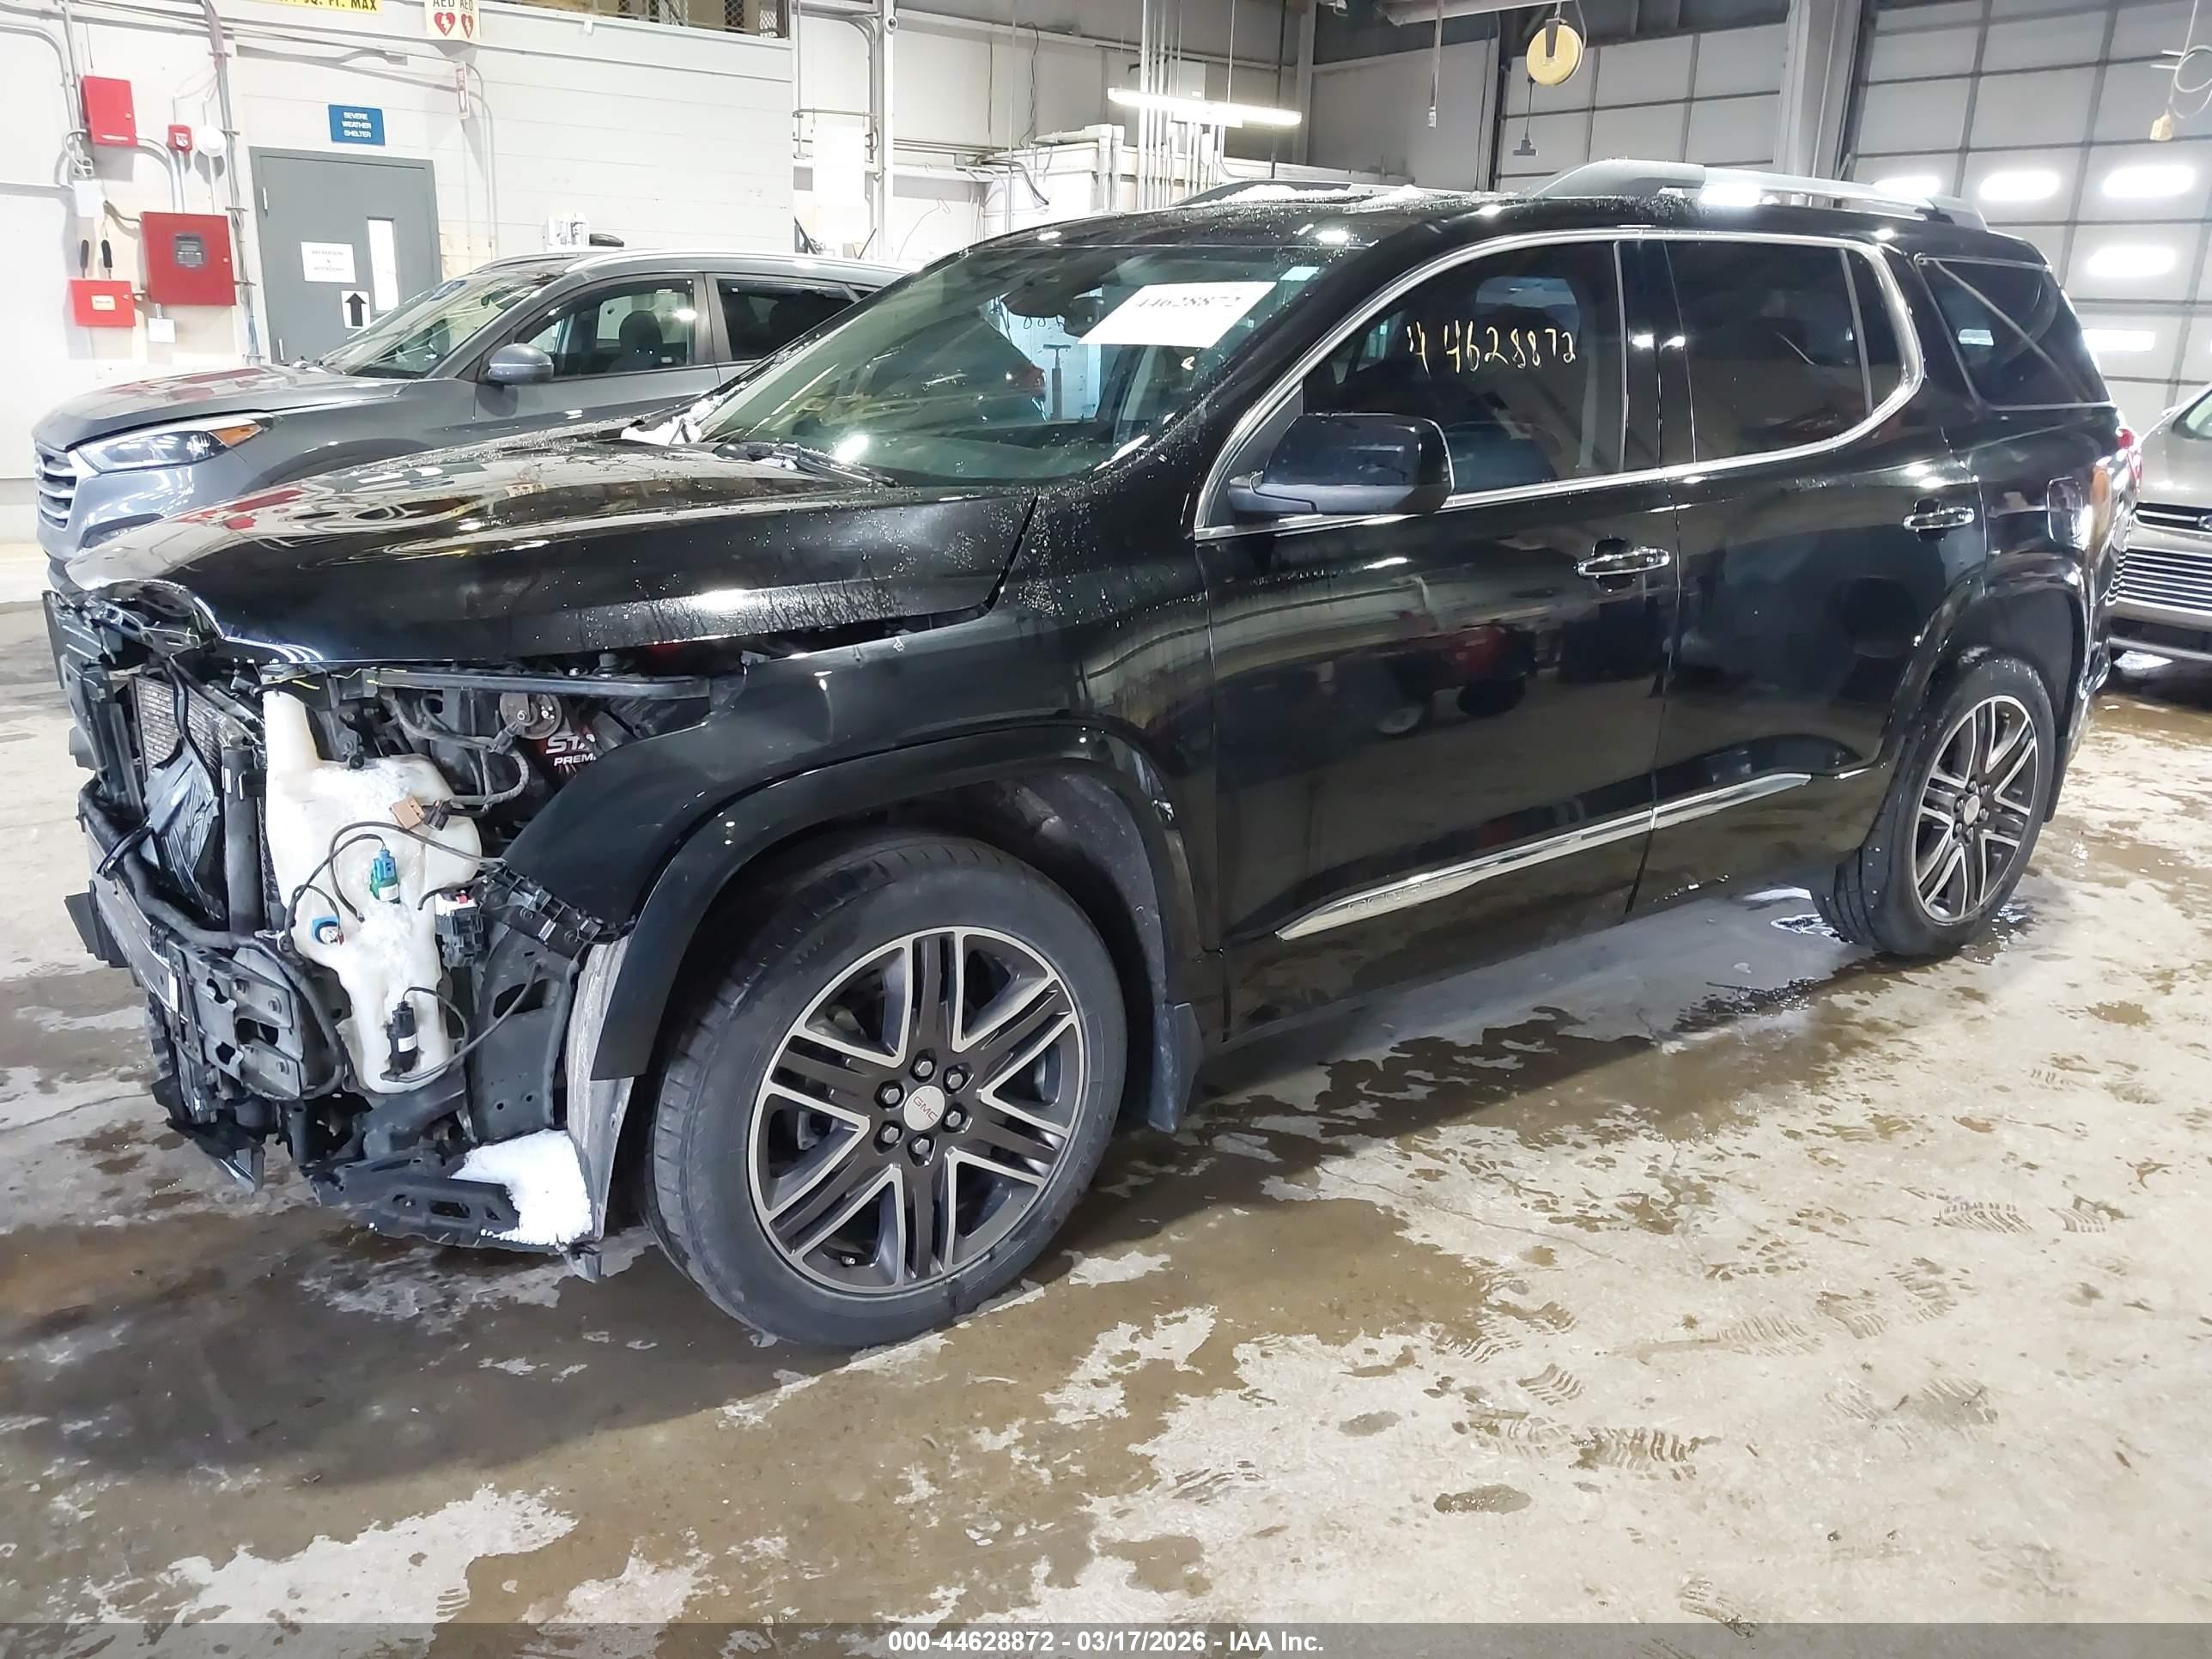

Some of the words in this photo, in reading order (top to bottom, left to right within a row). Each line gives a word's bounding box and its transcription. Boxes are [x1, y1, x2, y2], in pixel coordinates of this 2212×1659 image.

[350, 0, 377, 10] MAX
[459, 0, 473, 11] AED
[343, 112, 368, 120] SEVERE
[342, 120, 372, 129] WEATHER
[343, 130, 372, 138] SHELTER
[554, 753, 597, 766] PREM
[913, 1096, 939, 1123] GMC
